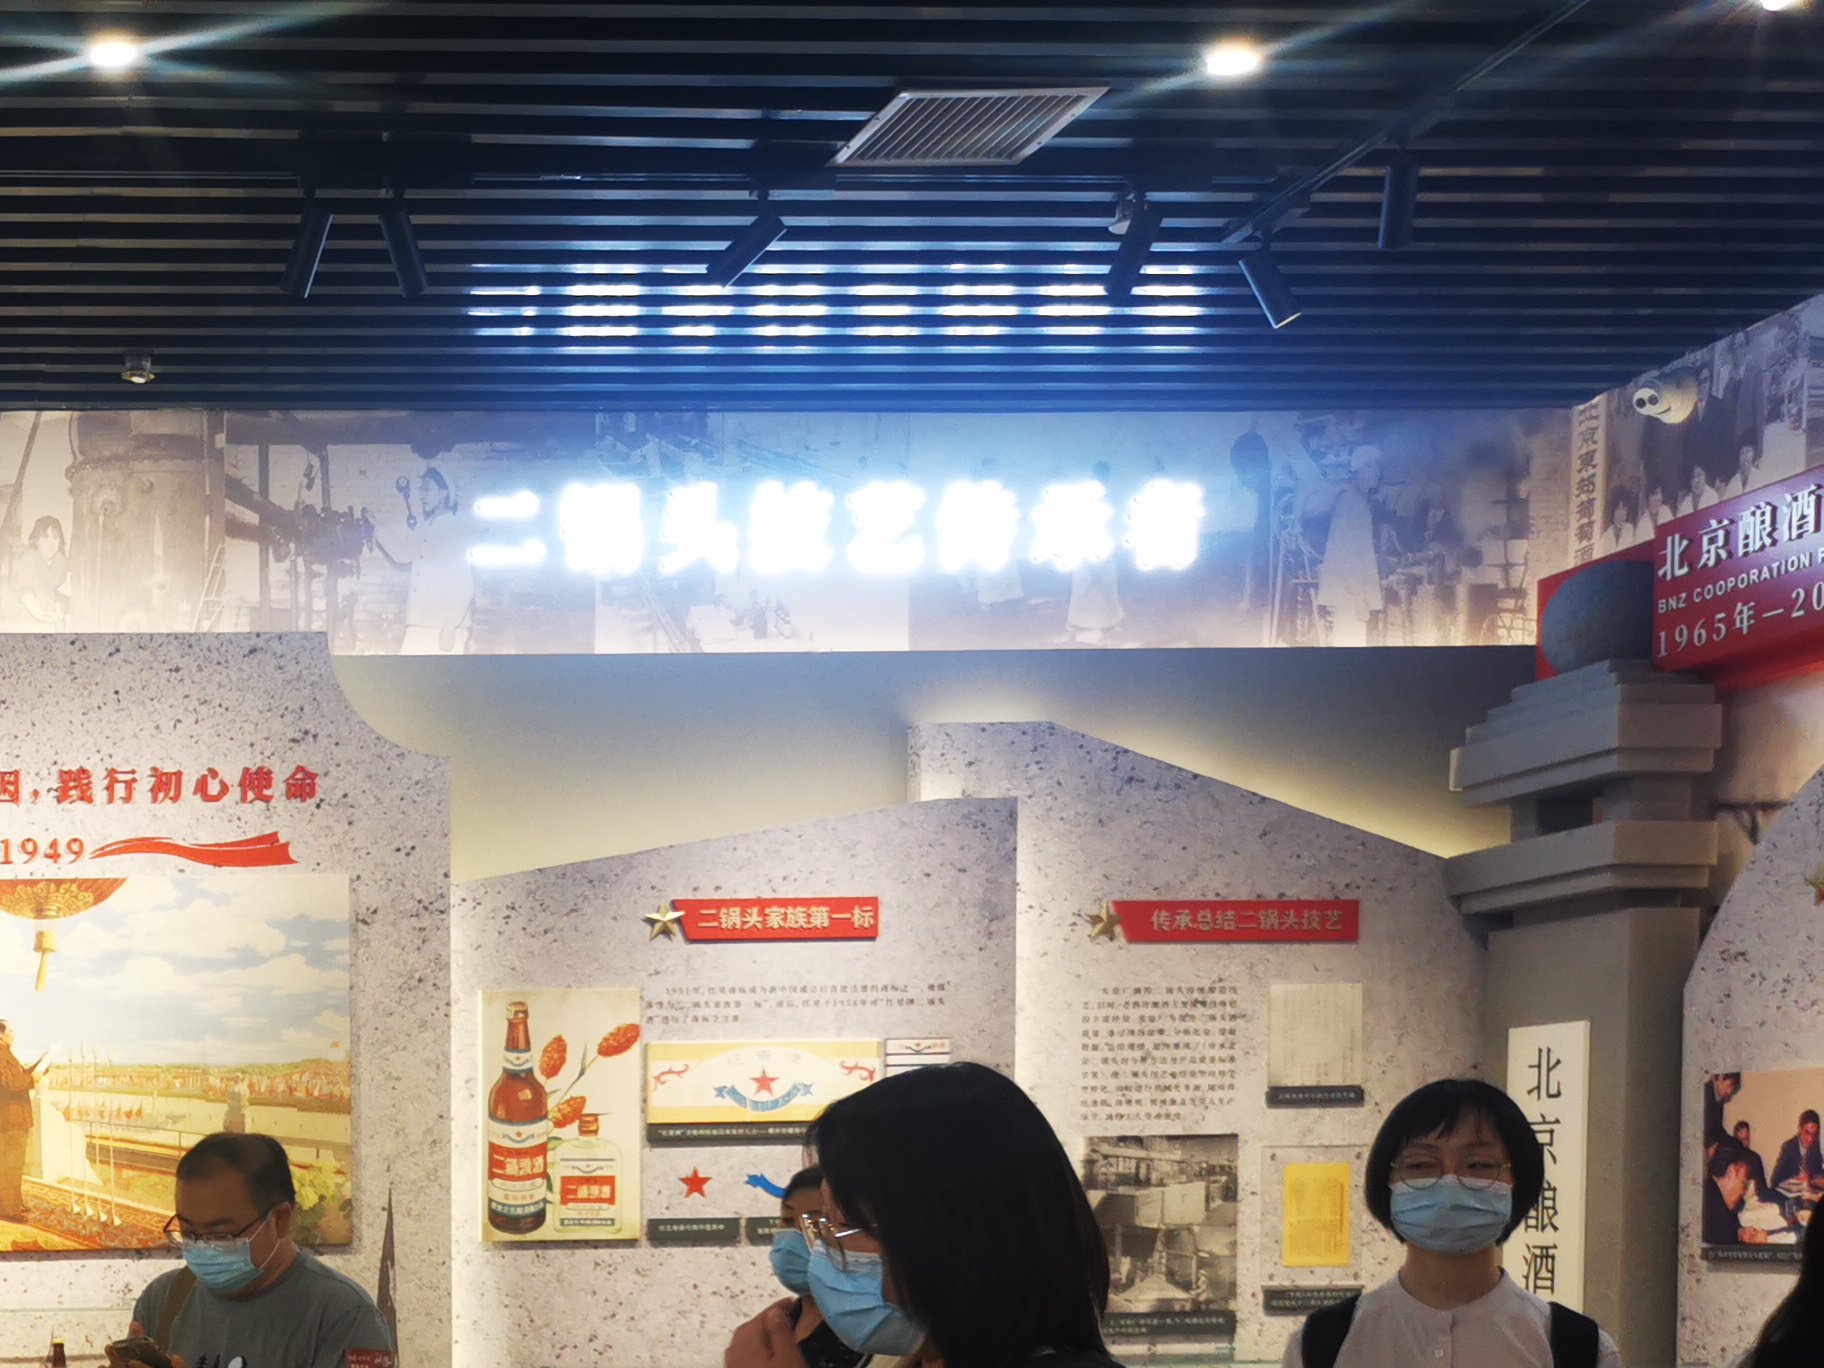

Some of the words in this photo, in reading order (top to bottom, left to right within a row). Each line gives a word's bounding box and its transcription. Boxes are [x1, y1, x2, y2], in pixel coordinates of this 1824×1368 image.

[1657, 483, 1820, 582] 北京酿酒
[1657, 592, 1688, 614] BNZ
[1692, 551, 1811, 603] COOPORATION
[0, 837, 85, 865] 1949
[697, 905, 875, 930] 二锅头家族第一标
[1151, 908, 1344, 932] 传承总结二锅头技艺
